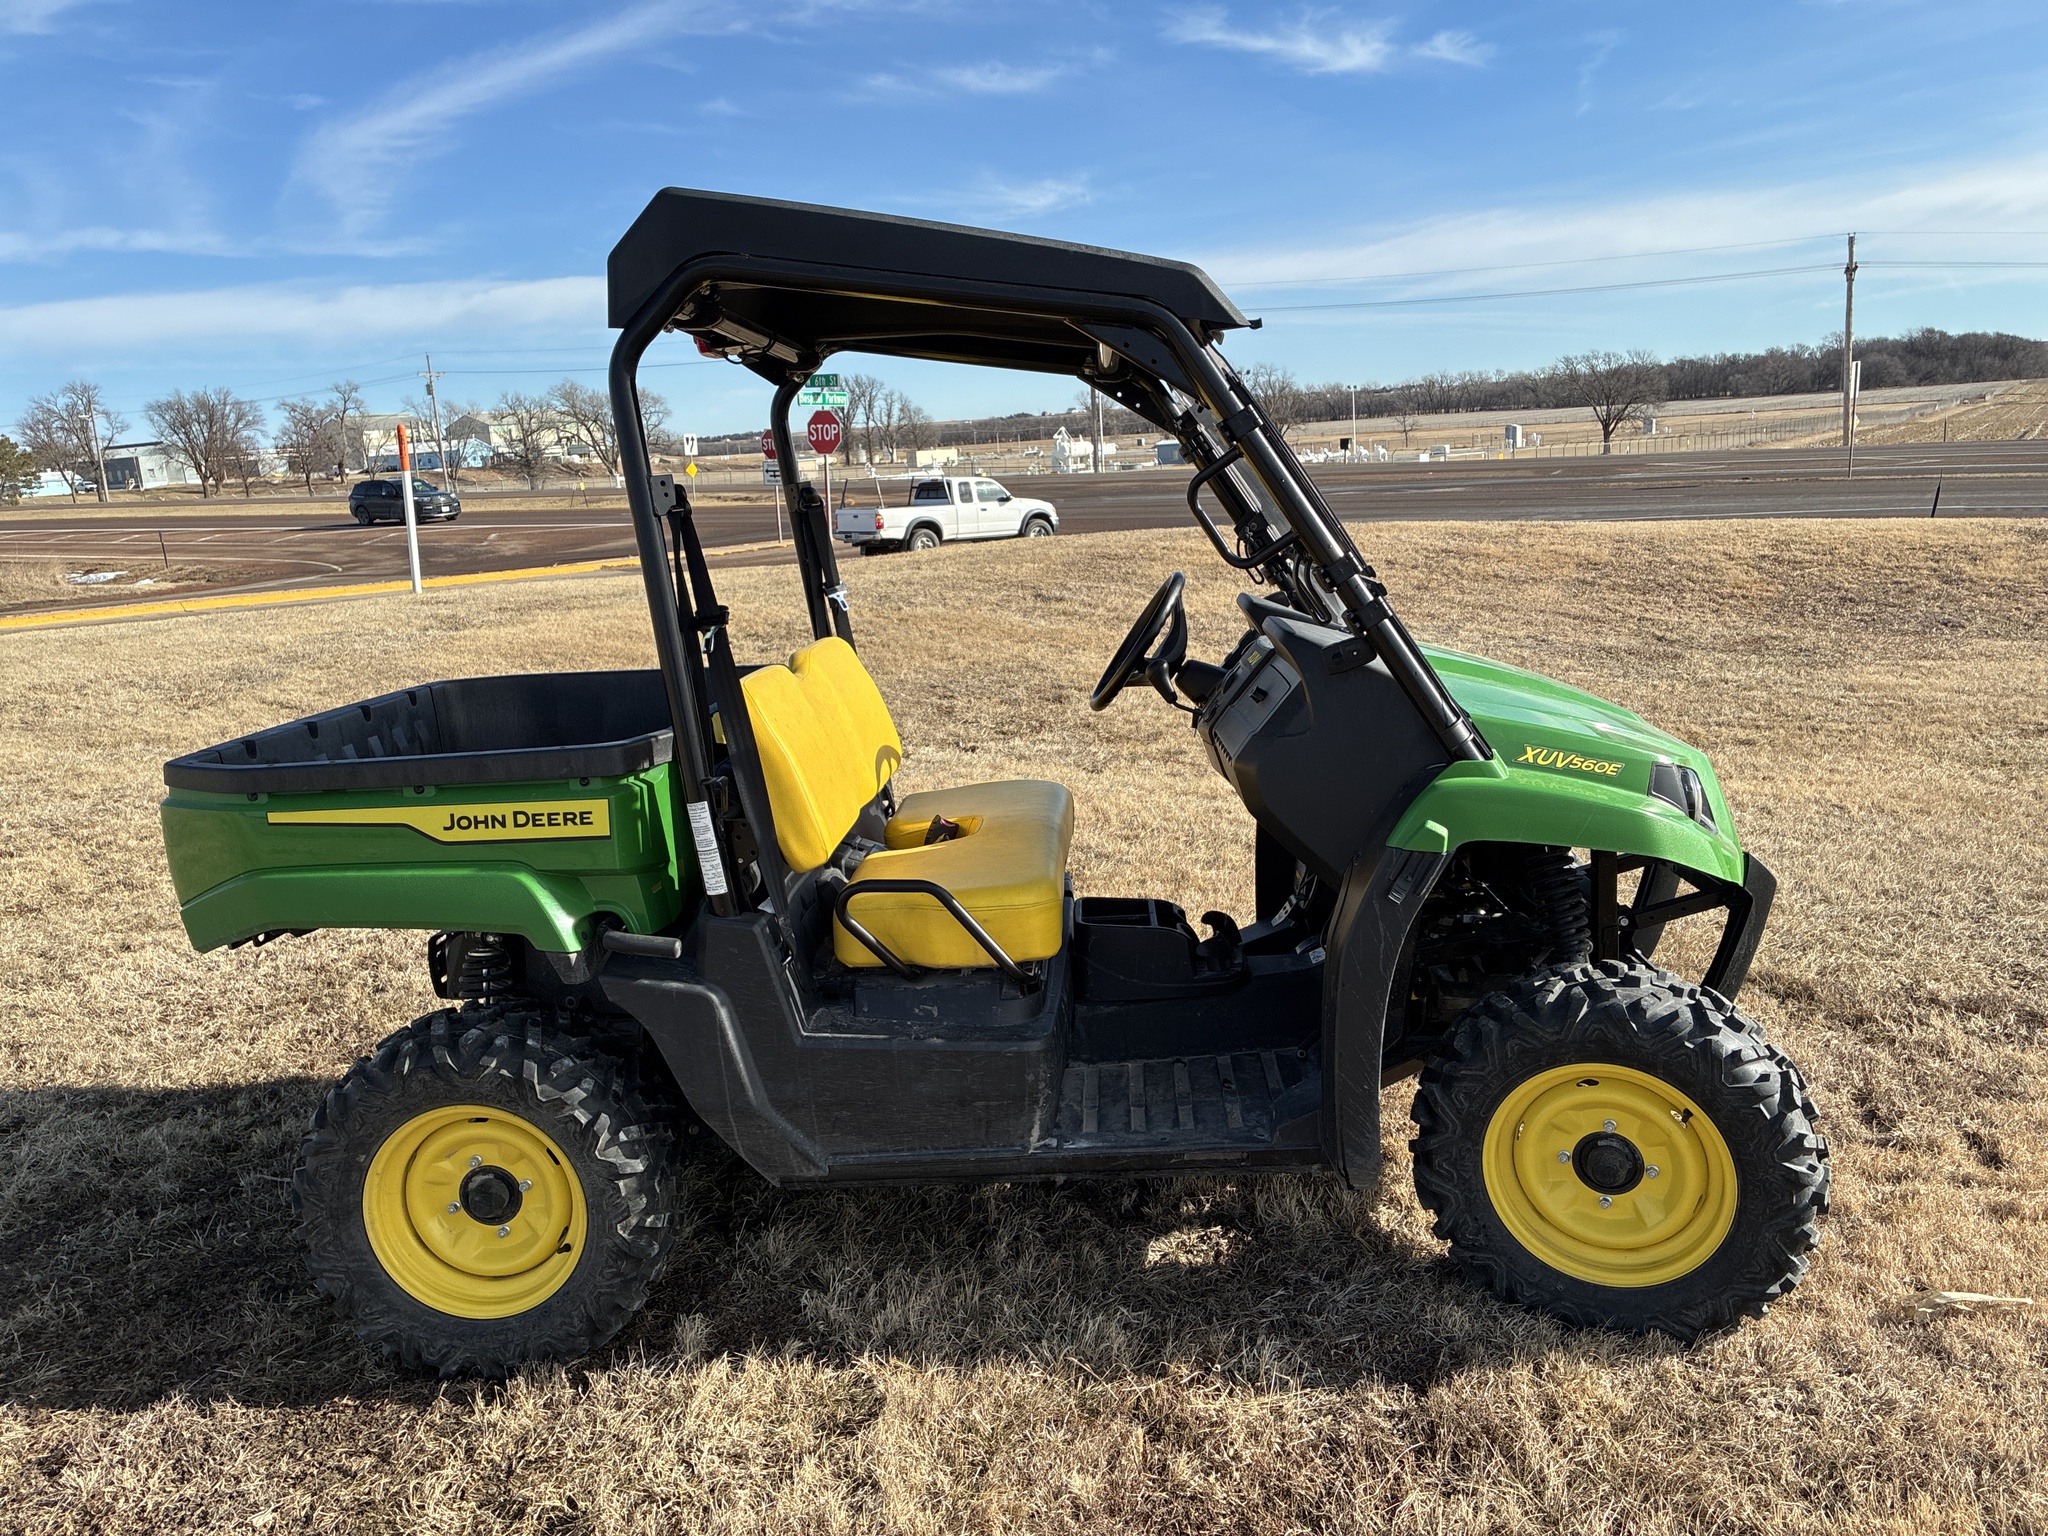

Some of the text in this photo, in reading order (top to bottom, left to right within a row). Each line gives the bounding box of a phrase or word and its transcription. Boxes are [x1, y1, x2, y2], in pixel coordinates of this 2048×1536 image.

[814, 376, 826, 387] 6th
[829, 375, 837, 386] St
[826, 393, 846, 405] Parkway
[809, 424, 839, 441] STOP
[763, 438, 776, 451] ST
[1517, 745, 1622, 776] XUV560E
[443, 810, 594, 831] JOHN DEERE
